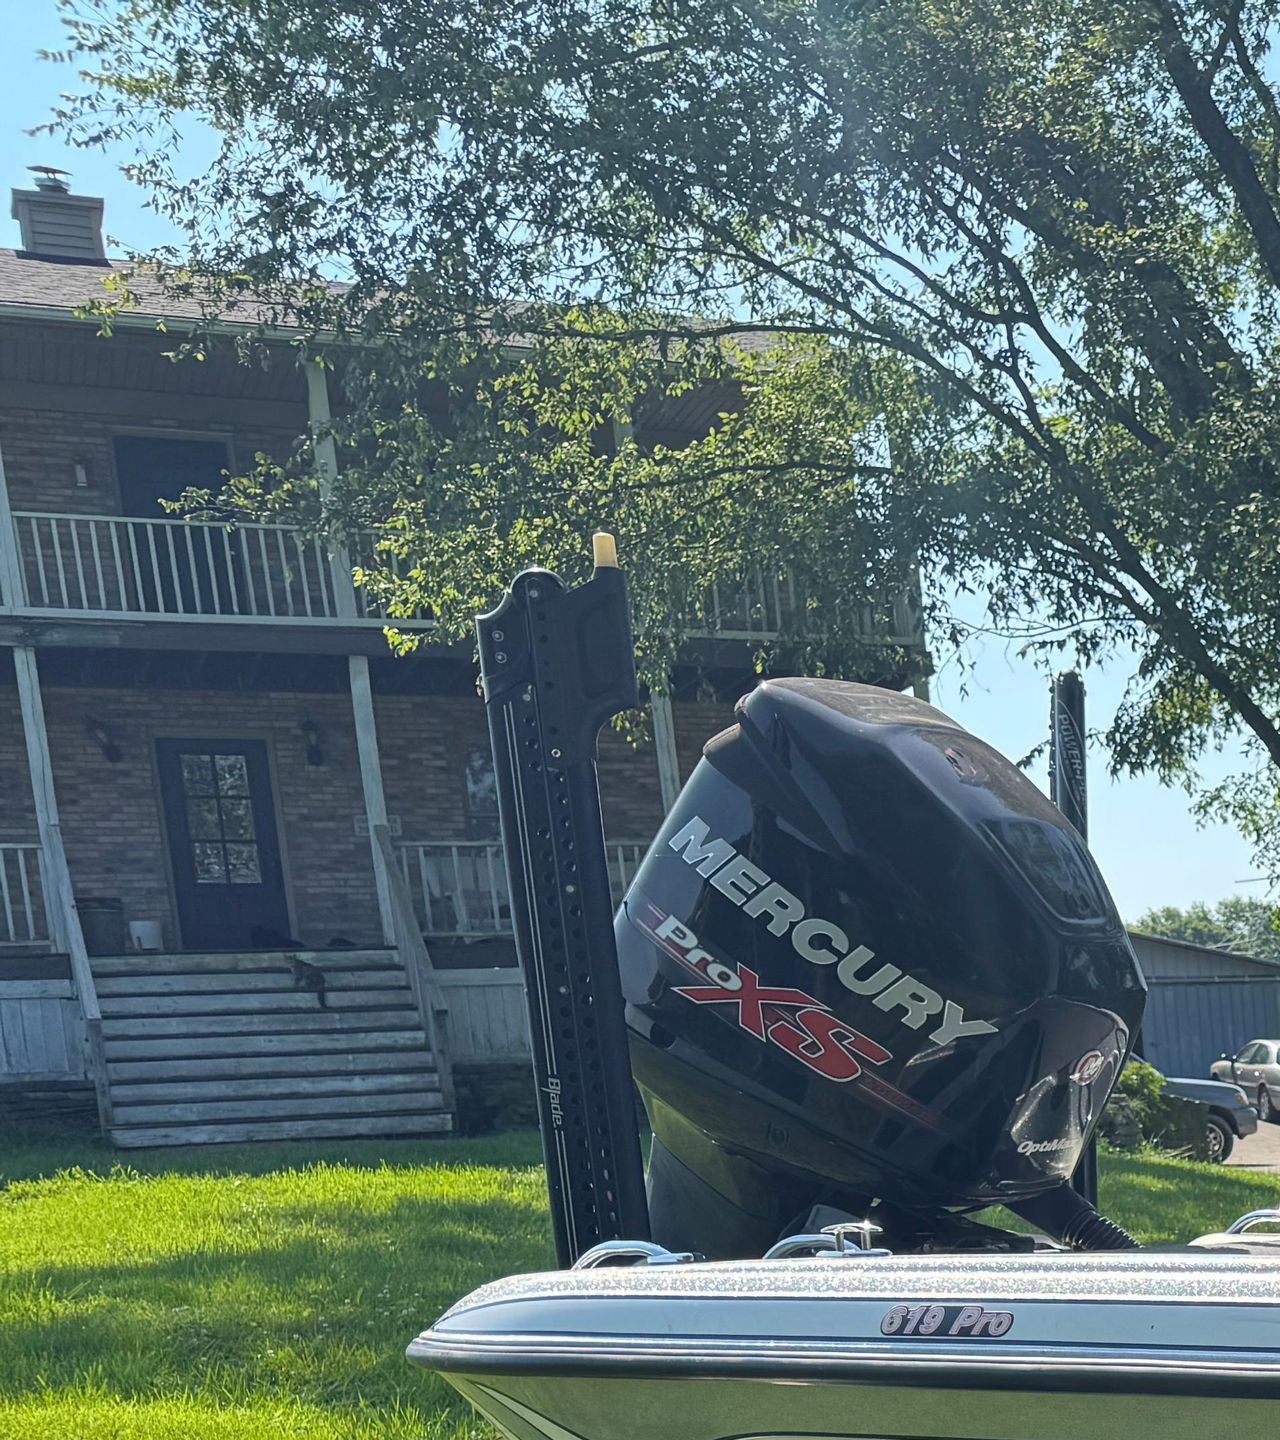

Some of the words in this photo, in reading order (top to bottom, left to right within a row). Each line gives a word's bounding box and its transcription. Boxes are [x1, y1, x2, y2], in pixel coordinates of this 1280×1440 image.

[655, 914, 742, 991] Pro
[668, 816, 999, 1046] MERCURY
[670, 961, 894, 1083] XS
[541, 1077, 564, 1128] Blade
[881, 1305, 946, 1335] 619
[949, 1305, 1014, 1336] Pro
